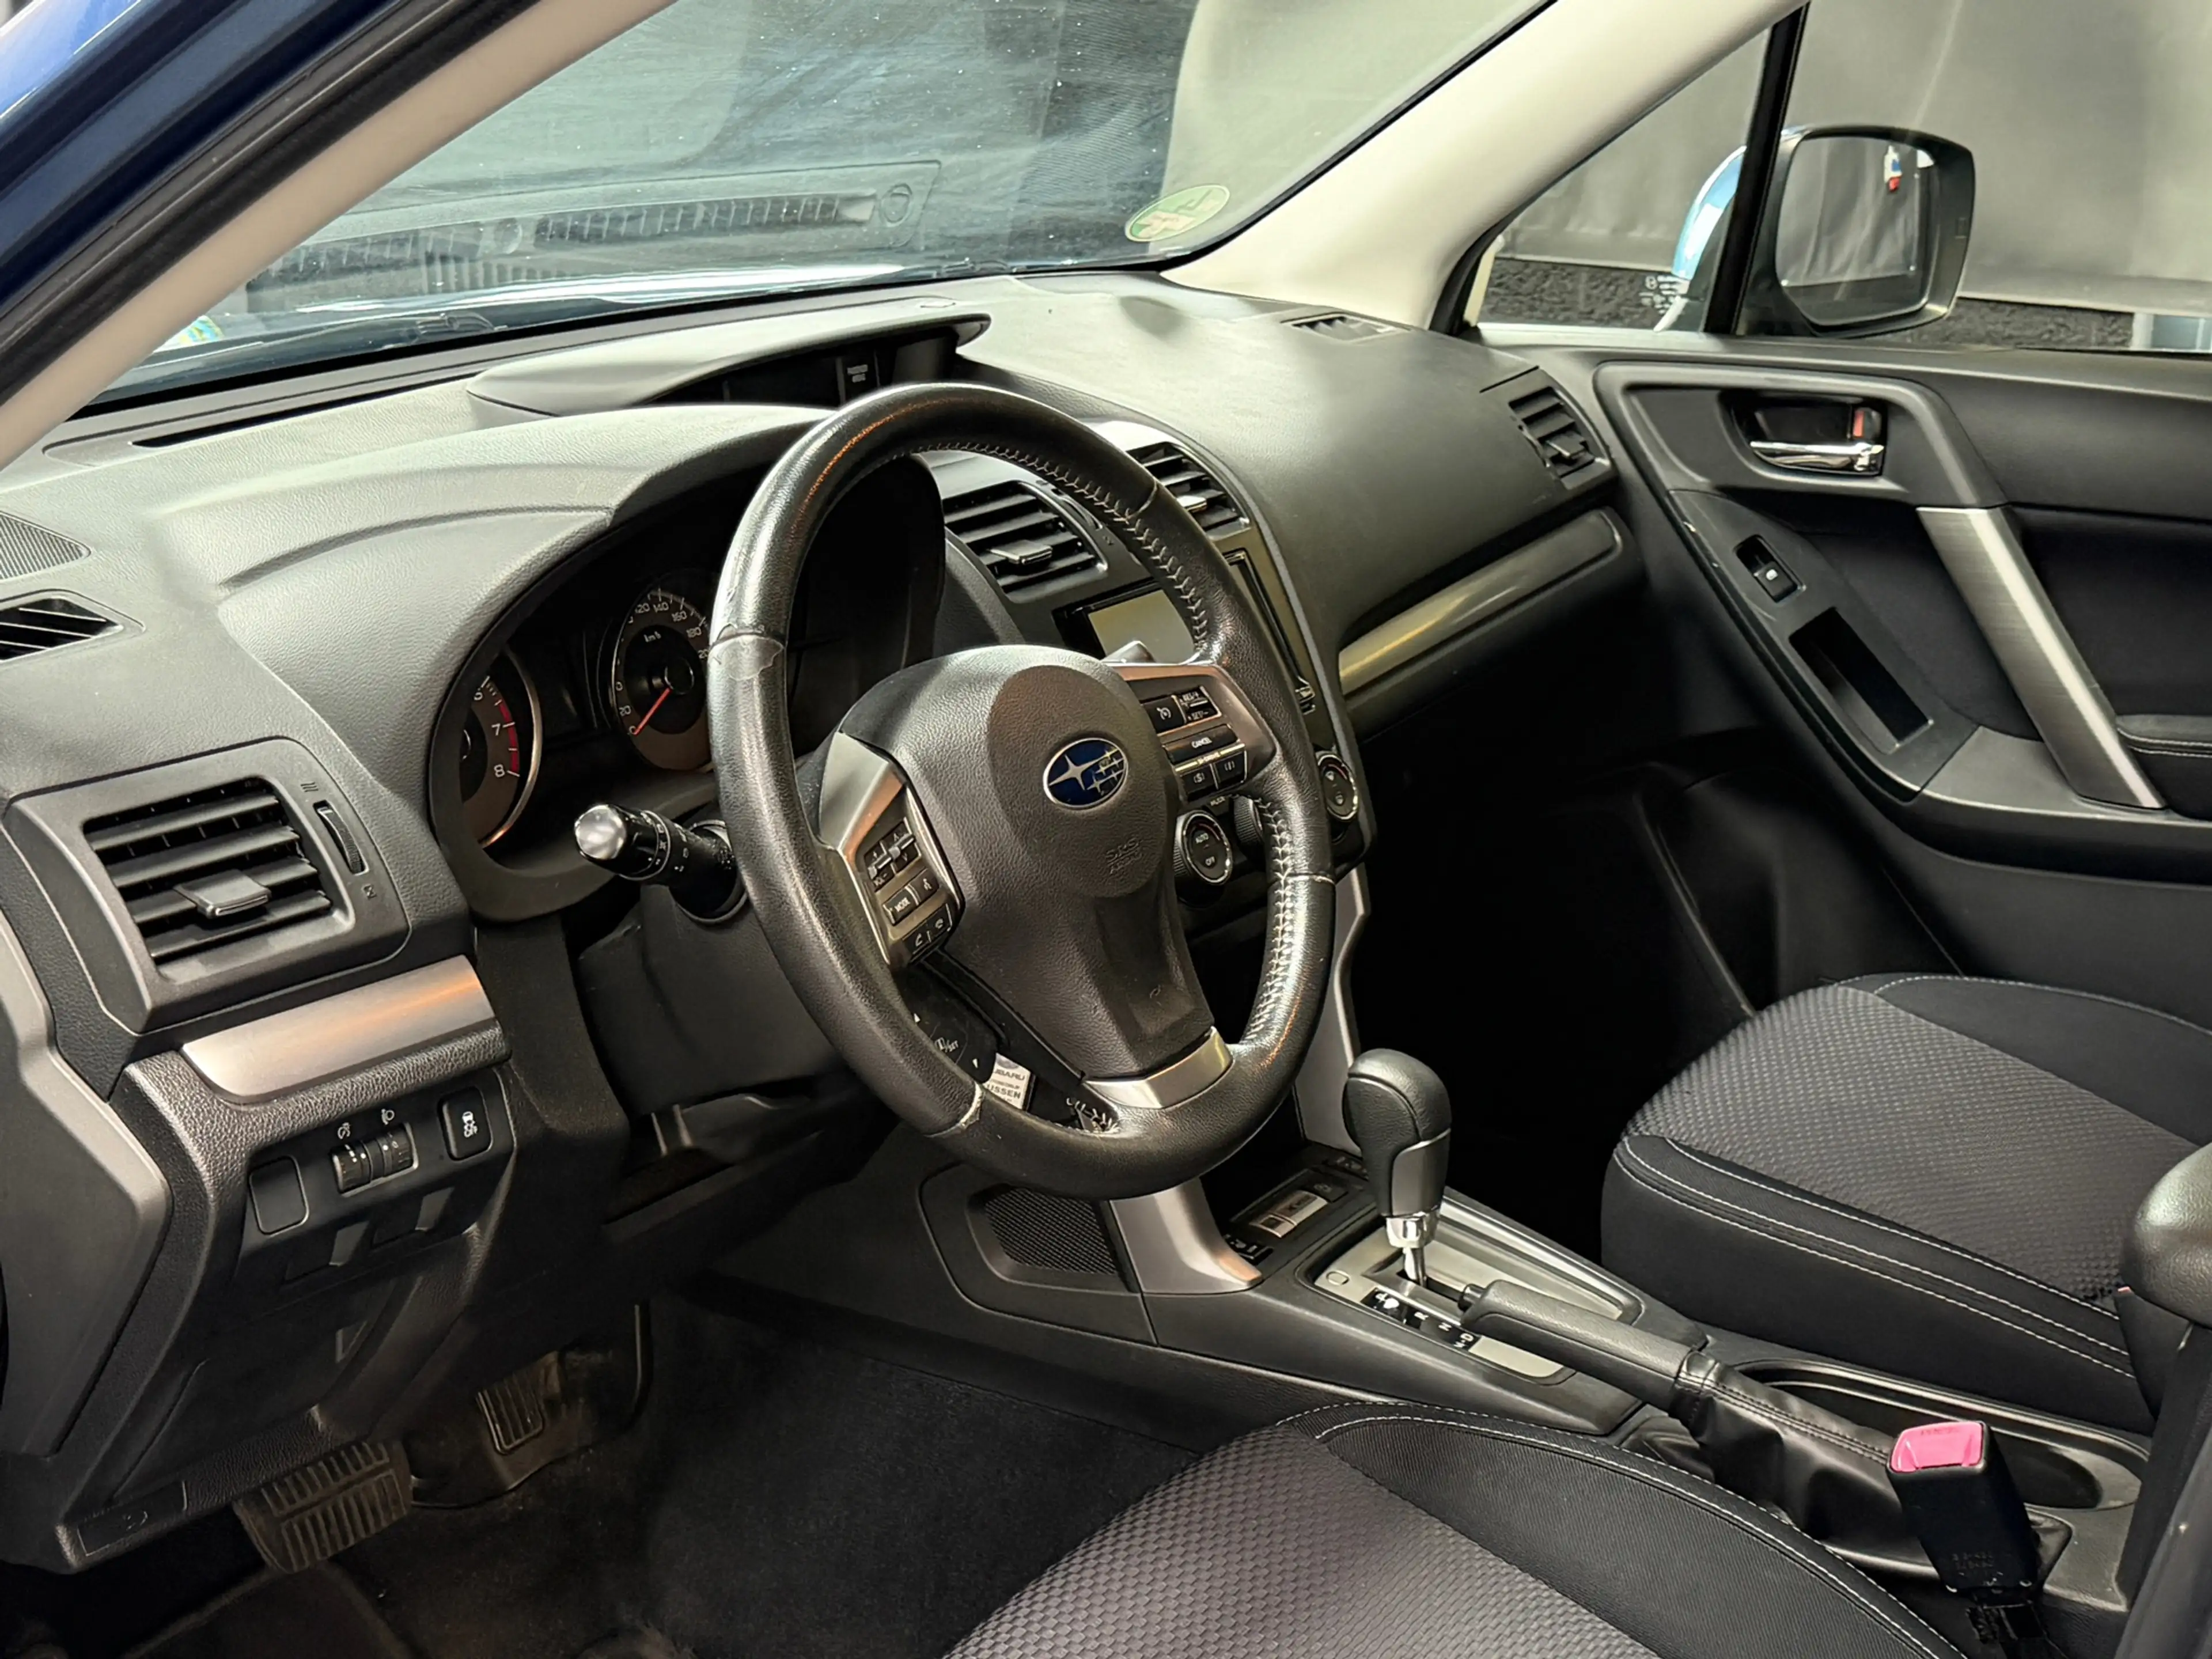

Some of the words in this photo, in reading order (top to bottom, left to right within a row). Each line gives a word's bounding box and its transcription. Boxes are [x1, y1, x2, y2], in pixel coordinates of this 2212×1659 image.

[491, 723, 501, 736] 7
[1191, 737, 1213, 749] CANCEL
[494, 764, 505, 777] 8
